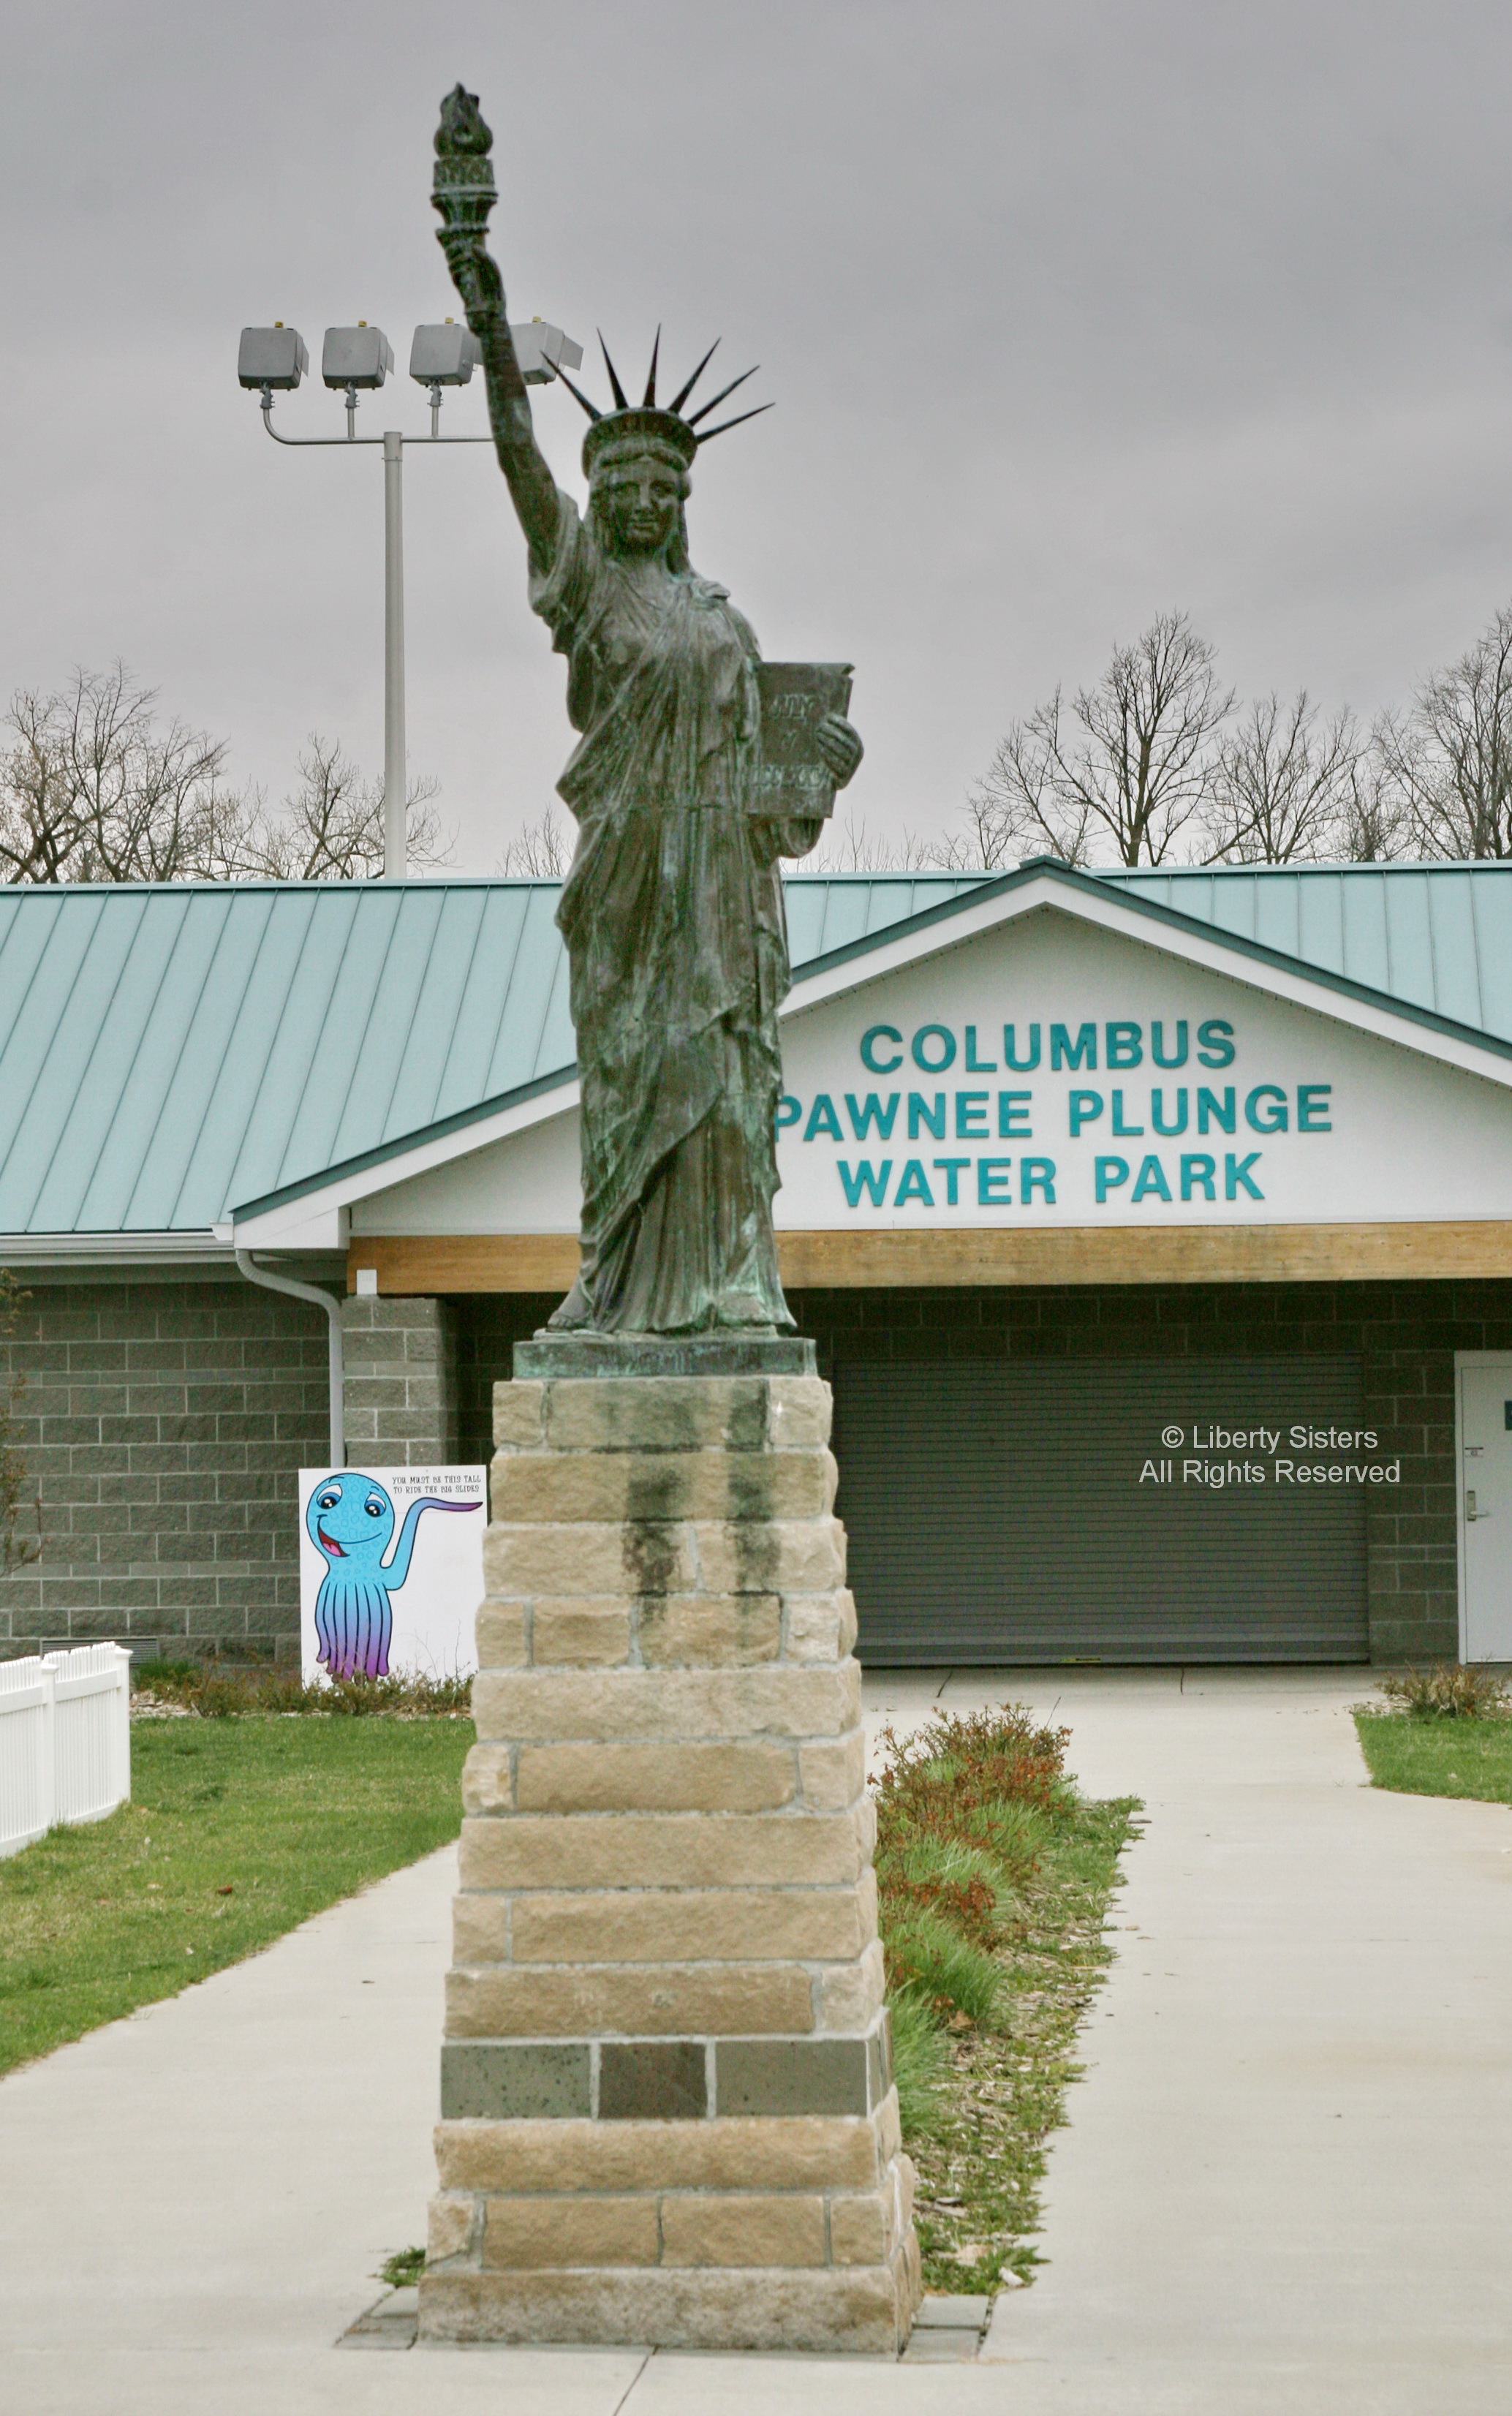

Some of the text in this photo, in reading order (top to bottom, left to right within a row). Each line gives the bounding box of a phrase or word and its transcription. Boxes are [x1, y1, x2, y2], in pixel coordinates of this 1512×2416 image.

[860, 1019, 1236, 1073] COLUMBUS
[774, 1084, 1331, 1143] PAWNEE PLUNGE
[836, 1152, 1265, 1207] WATER PARK
[405, 1486, 421, 1494] RIDE
[455, 1484, 480, 1492] SLIDES
[445, 1476, 461, 1484] THIS
[464, 1475, 481, 1483] TALL
